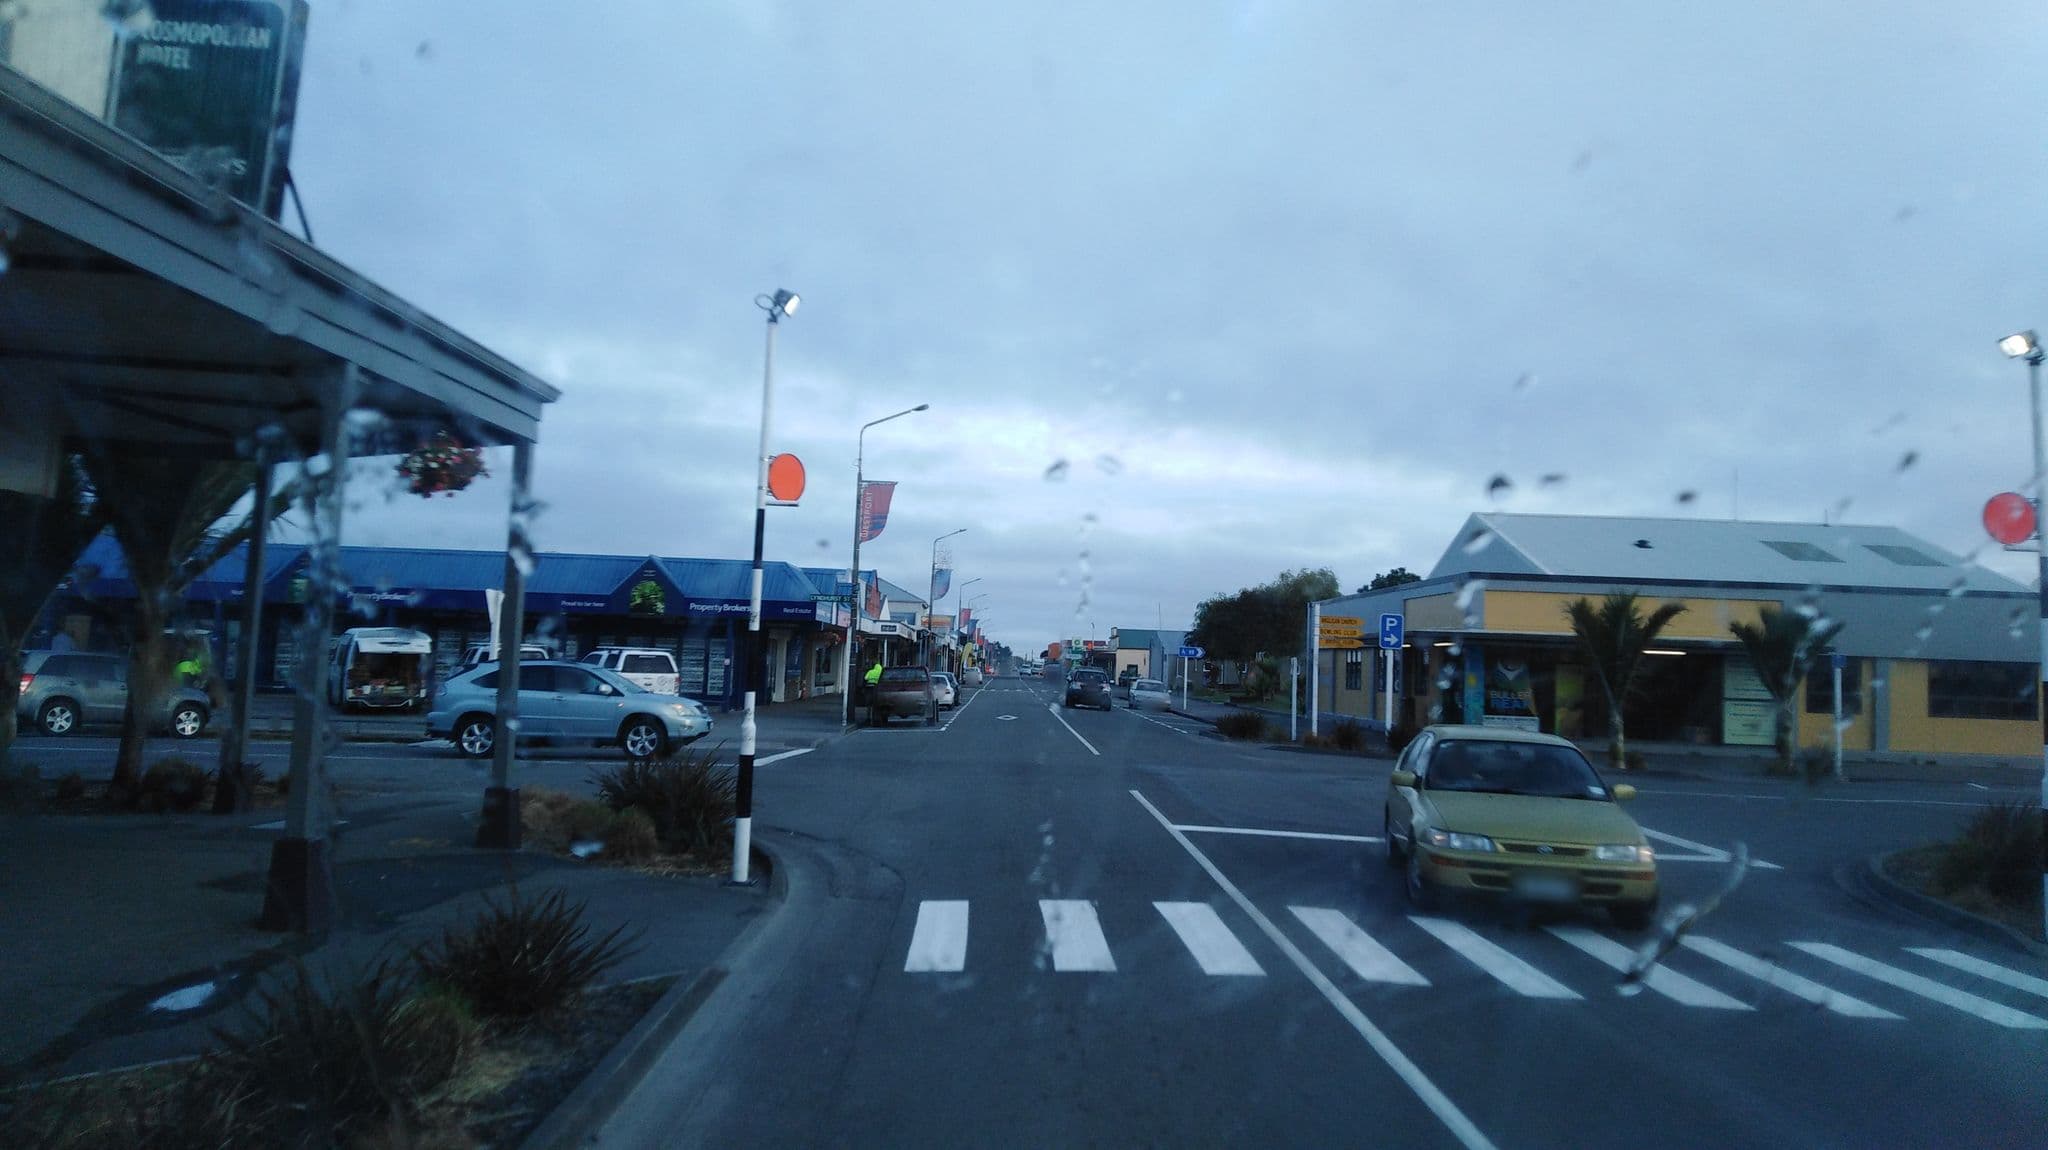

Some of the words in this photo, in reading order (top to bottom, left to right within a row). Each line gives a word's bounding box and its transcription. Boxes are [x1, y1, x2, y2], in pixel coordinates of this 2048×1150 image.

[136, 43, 192, 69] HOTEL
[689, 602, 723, 614] Property
[1386, 617, 1398, 632] P
